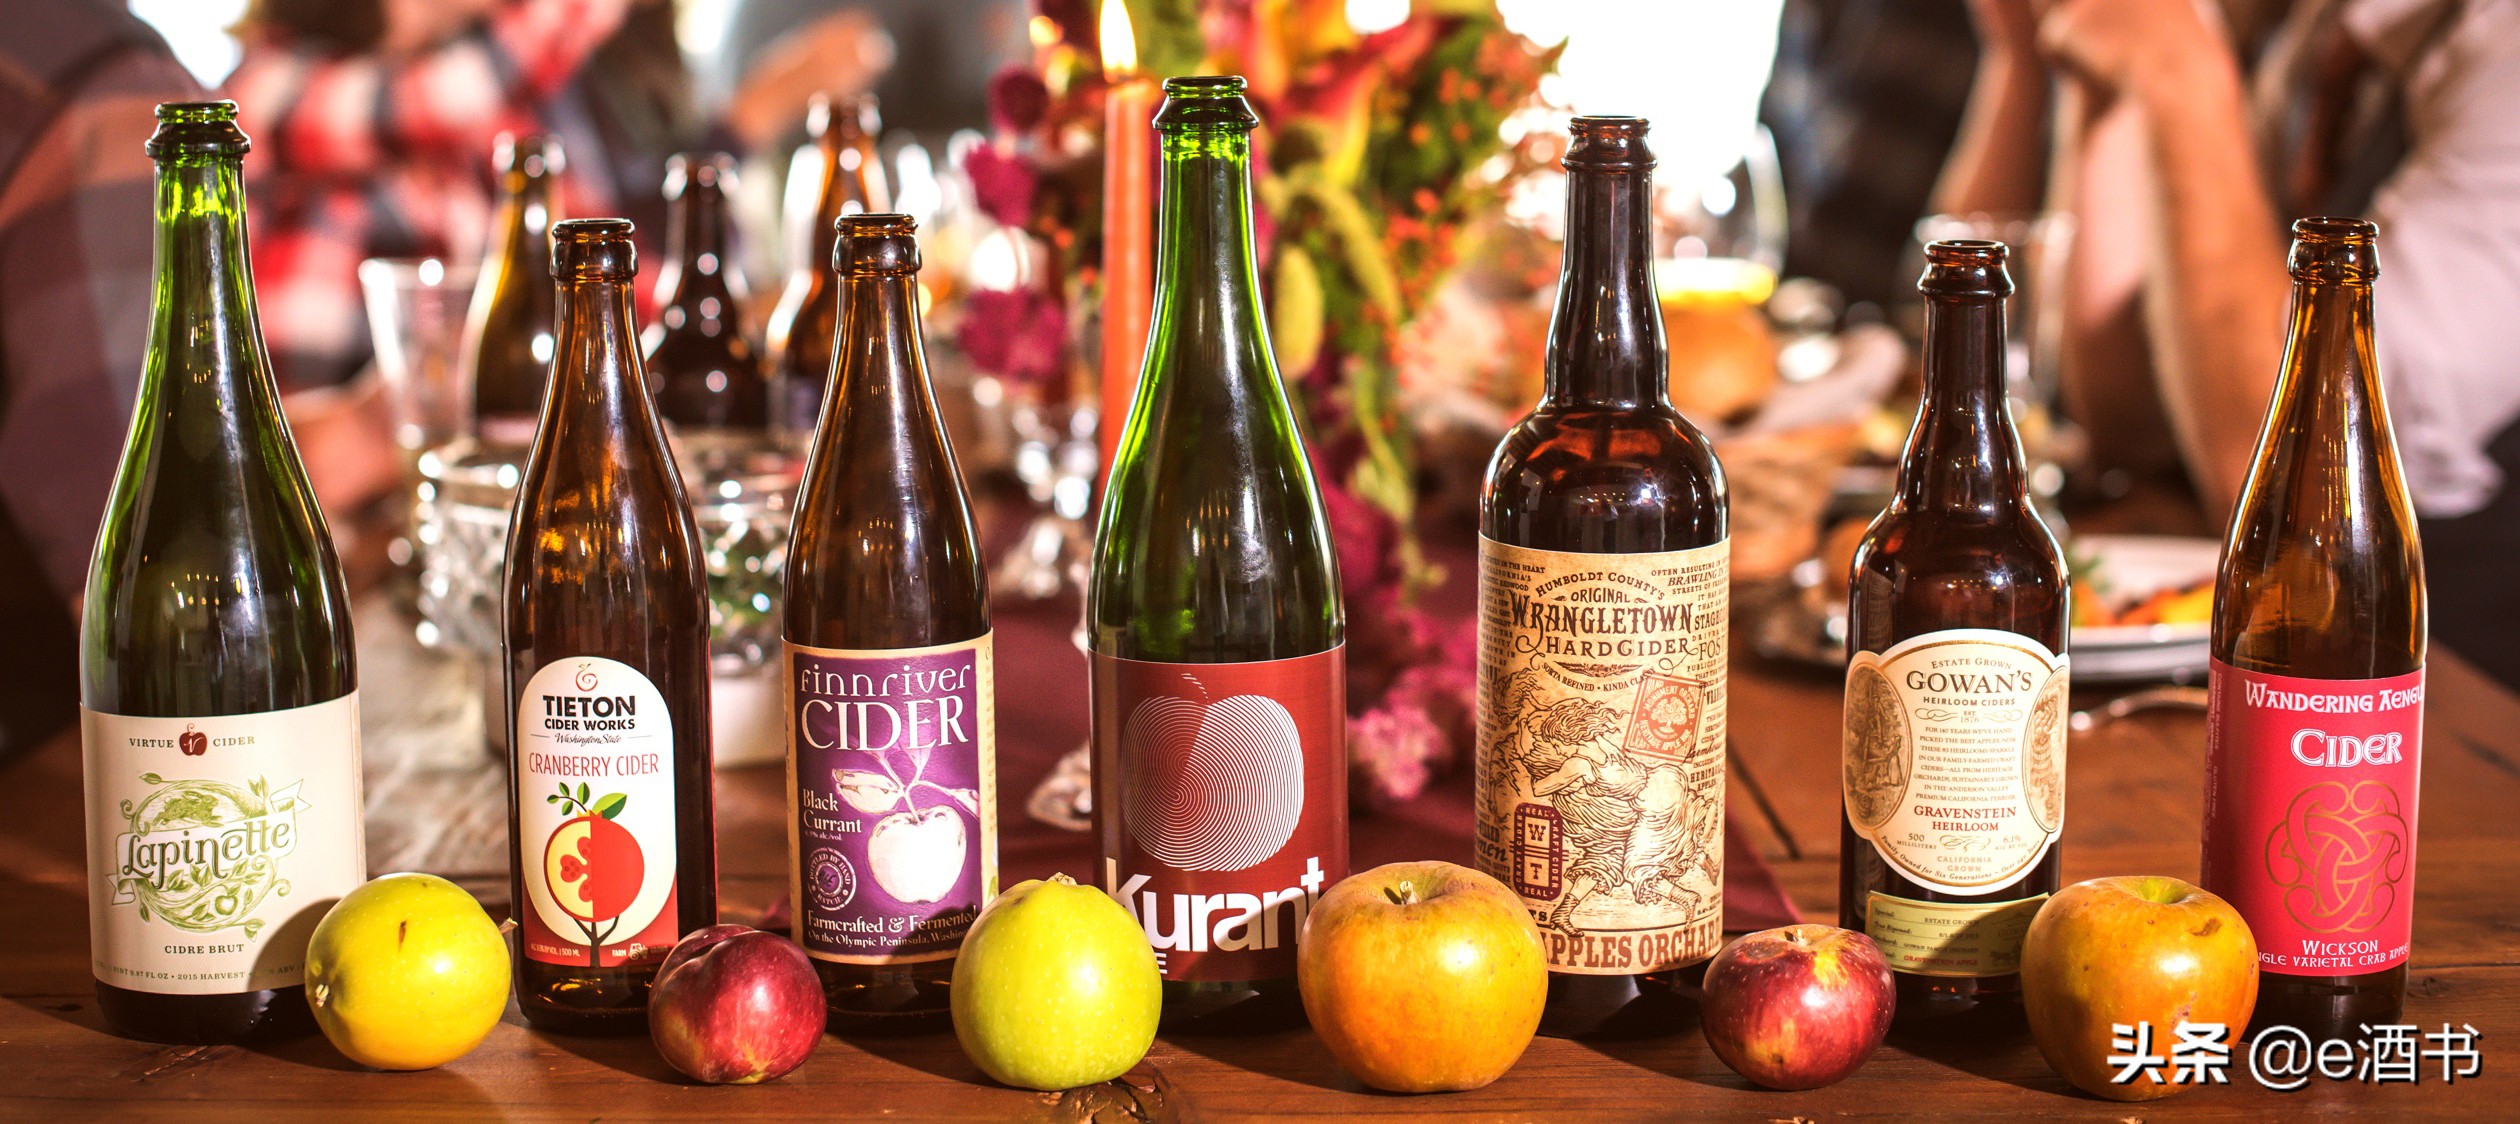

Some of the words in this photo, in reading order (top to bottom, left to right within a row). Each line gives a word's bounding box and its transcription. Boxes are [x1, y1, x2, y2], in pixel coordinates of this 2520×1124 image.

[1522, 564, 1546, 574] HEART
[1650, 568, 1678, 577] OFTEN
[1667, 568, 1718, 588] BRAWLING
[1535, 571, 1604, 598] HUMBOLDT
[1607, 571, 1665, 601] COUNTY'S
[1671, 584, 1703, 596] STREETS
[1570, 587, 1631, 605] ORIGINAL
[1508, 589, 1693, 640] WRANGLETOWN
[1931, 658, 1971, 670] ESTATE
[1974, 657, 2012, 670] GROWN
[801, 663, 971, 697] finnriver
[1562, 678, 1595, 692] REFINED
[1602, 680, 1630, 693] KINDA
[1906, 669, 2033, 694] GOWAN'S
[1923, 696, 1978, 707] HEIRLOOM
[1981, 698, 2016, 706] CIDERS
[2245, 679, 2374, 714] WANDERING
[542, 694, 636, 718] TIETON
[544, 718, 580, 731] CIDER
[583, 718, 636, 731] WORKS
[802, 695, 969, 751] CIDER
[1925, 726, 1939, 734] FOR
[1950, 728, 1972, 736] YEARS
[129, 738, 174, 748] VIRTUE
[213, 736, 256, 747] CIDER
[1919, 735, 1944, 744] PICKED
[1945, 737, 1960, 745] THE
[1921, 745, 1942, 753] THESE
[2290, 727, 2404, 768] CIDER
[528, 752, 611, 777] CRANBERRY
[616, 753, 659, 776] CIDER
[1927, 755, 1943, 763] OUR
[803, 788, 839, 812] Black
[1915, 792, 1947, 801] PREMIUM
[1525, 807, 1550, 817] REAL
[1913, 804, 2017, 819] GRAVENSTEIN
[803, 809, 862, 833] Currant
[1932, 820, 1999, 832] HEIRLOOM
[1527, 823, 1547, 842] W
[1551, 818, 1560, 855] CRAFT
[1908, 832, 1925, 843] 500
[1896, 839, 1937, 850] MILLILITERS
[121, 819, 291, 890] Lapinette
[1881, 834, 1900, 856] Family
[1900, 853, 1922, 871] Owned
[1921, 866, 1933, 877] for
[1934, 869, 1948, 879] Six
[1948, 872, 1993, 882] Generations
[1936, 855, 1992, 864] CALIFORNIA
[1529, 861, 1543, 880] T
[1550, 856, 1559, 889] CIDER
[1947, 865, 1982, 873] GROWN
[1523, 888, 1549, 898] REAL
[1106, 856, 1325, 953] Kurant
[808, 910, 884, 934] Farmcrafted
[888, 917, 905, 934] &
[909, 904, 978, 932] Fermented
[821, 931, 834, 944] the
[836, 933, 877, 949] Olympic
[930, 929, 969, 943] Washin
[2302, 939, 2379, 957] WICKSON
[164, 945, 204, 954] CIDRE
[209, 943, 245, 954] BRUT
[1540, 931, 1632, 968] PPLES
[2293, 955, 2354, 969] VARIETAL
[2358, 951, 2387, 967] CRAB
[2389, 942, 2409, 962] APPLE
[146, 969, 156, 978] FL
[157, 970, 169, 979] OZ
[200, 971, 245, 980] HARVEST
